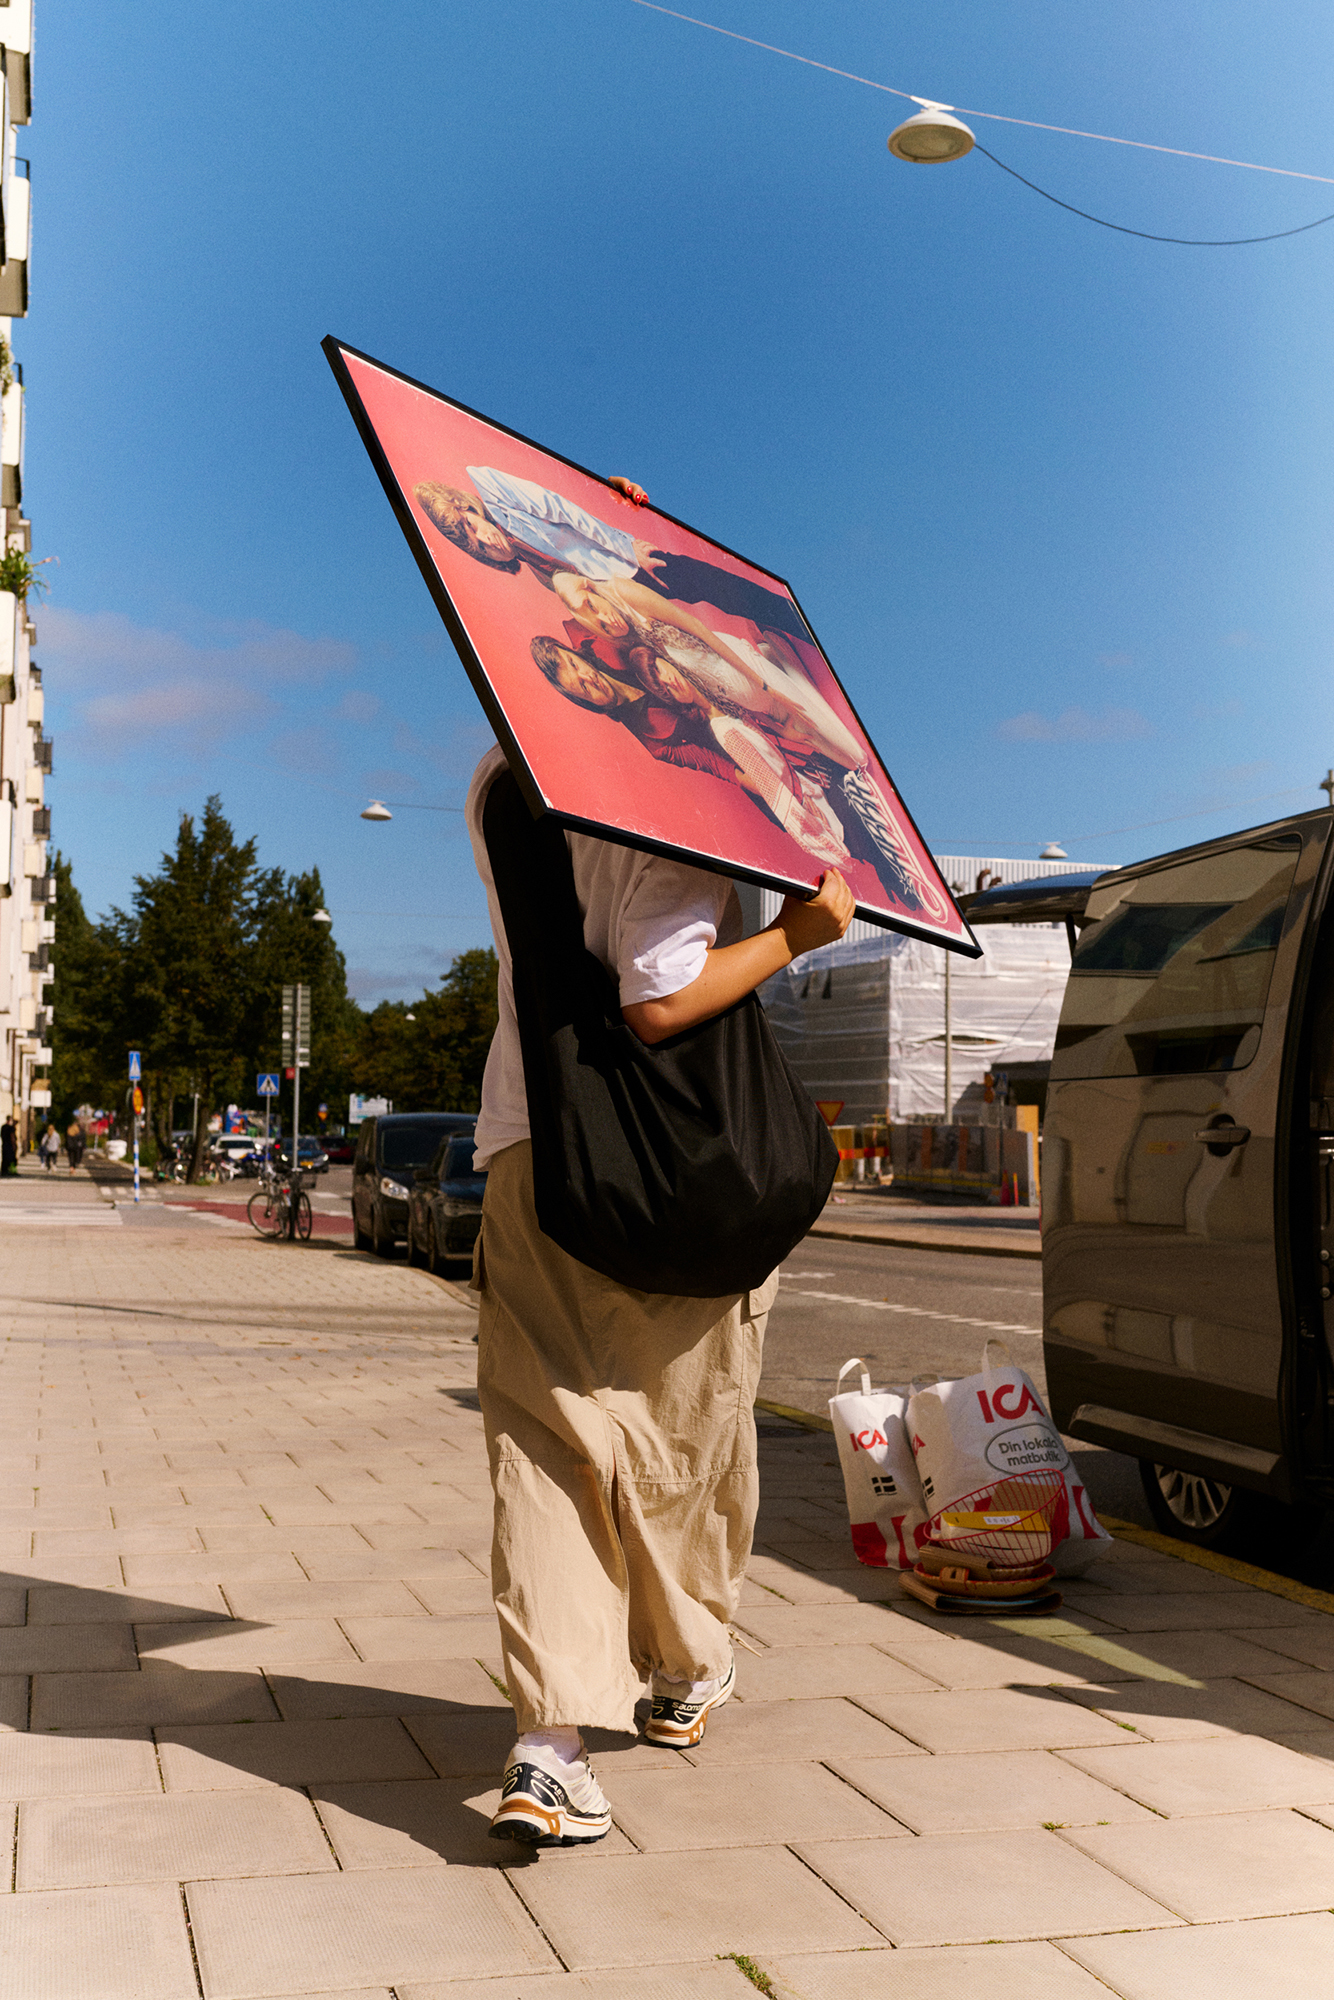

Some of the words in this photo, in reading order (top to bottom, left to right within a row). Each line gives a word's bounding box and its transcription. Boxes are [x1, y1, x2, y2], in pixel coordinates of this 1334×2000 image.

[844, 769, 946, 920] ABBA
[976, 1383, 1045, 1423] ICA
[849, 1429, 889, 1452] ICA
[998, 1441, 1022, 1454] Din
[1007, 1450, 1061, 1467] matbutik
